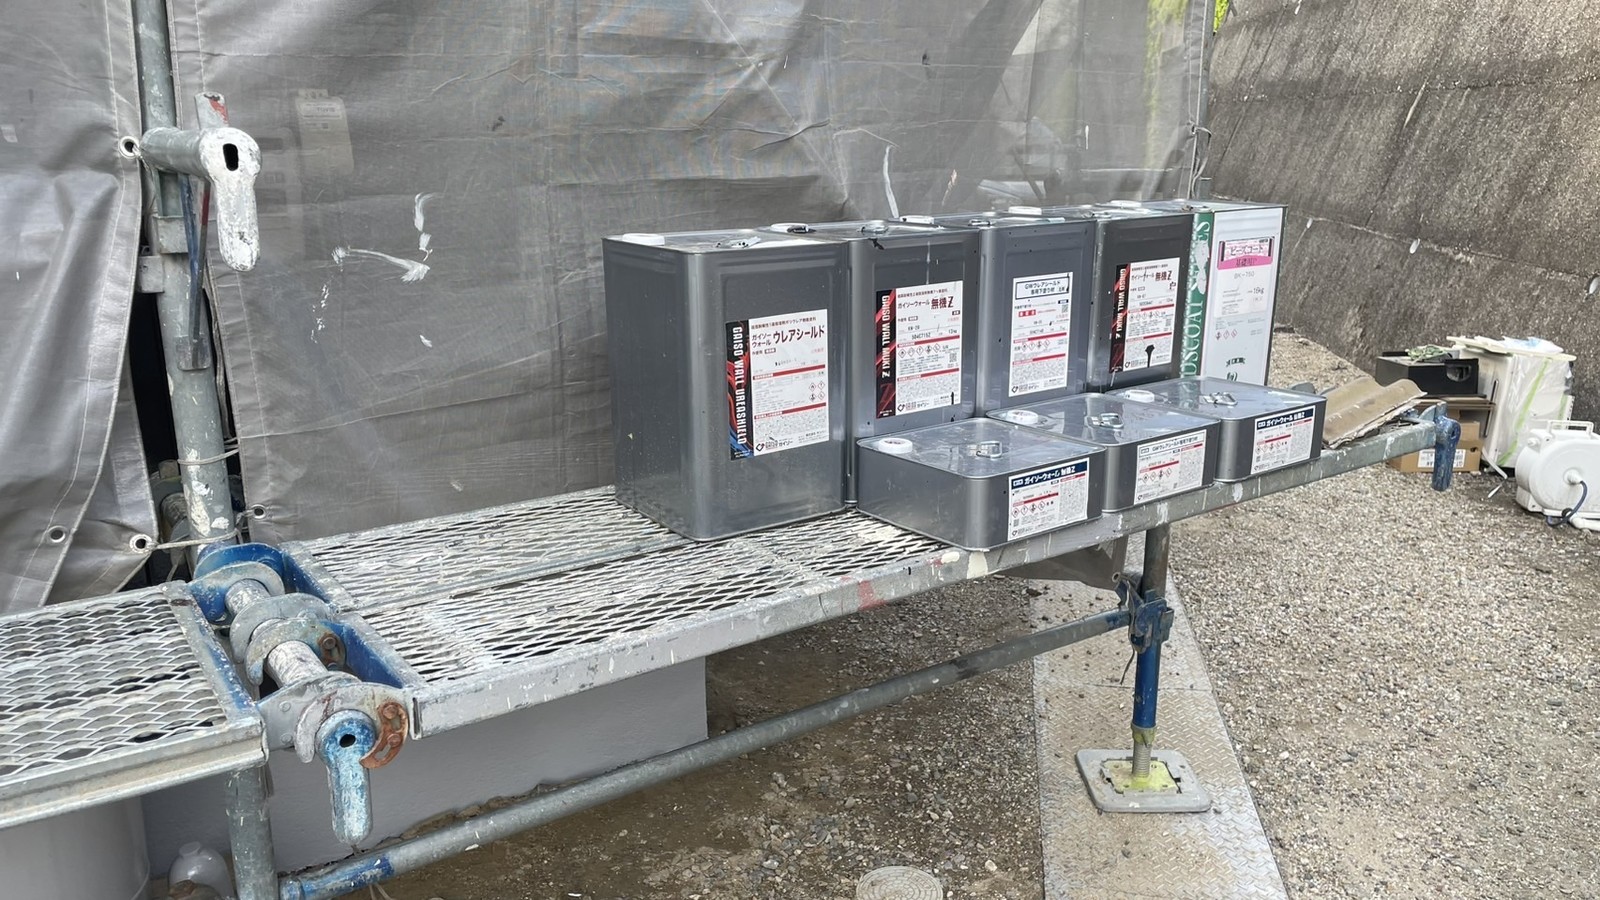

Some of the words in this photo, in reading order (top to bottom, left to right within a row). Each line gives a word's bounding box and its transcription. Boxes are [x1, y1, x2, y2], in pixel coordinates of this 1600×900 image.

[881, 295, 891, 321] GAISO
[897, 299, 930, 310] ガイソーウォール
[931, 296, 954, 310] 無機Z
[1117, 291, 1125, 311] WALL
[1115, 313, 1123, 332] MUKI
[732, 326, 744, 357] GAISO
[751, 340, 771, 349] ウォール
[752, 333, 772, 341] ガイソー
[773, 324, 825, 345] ウレアシールド
[881, 323, 891, 346] WALL
[882, 347, 891, 369] MUKI
[734, 359, 746, 386] WALL
[735, 388, 747, 445] UREASHIELD
[1024, 469, 1060, 485] ガイソーウォール
